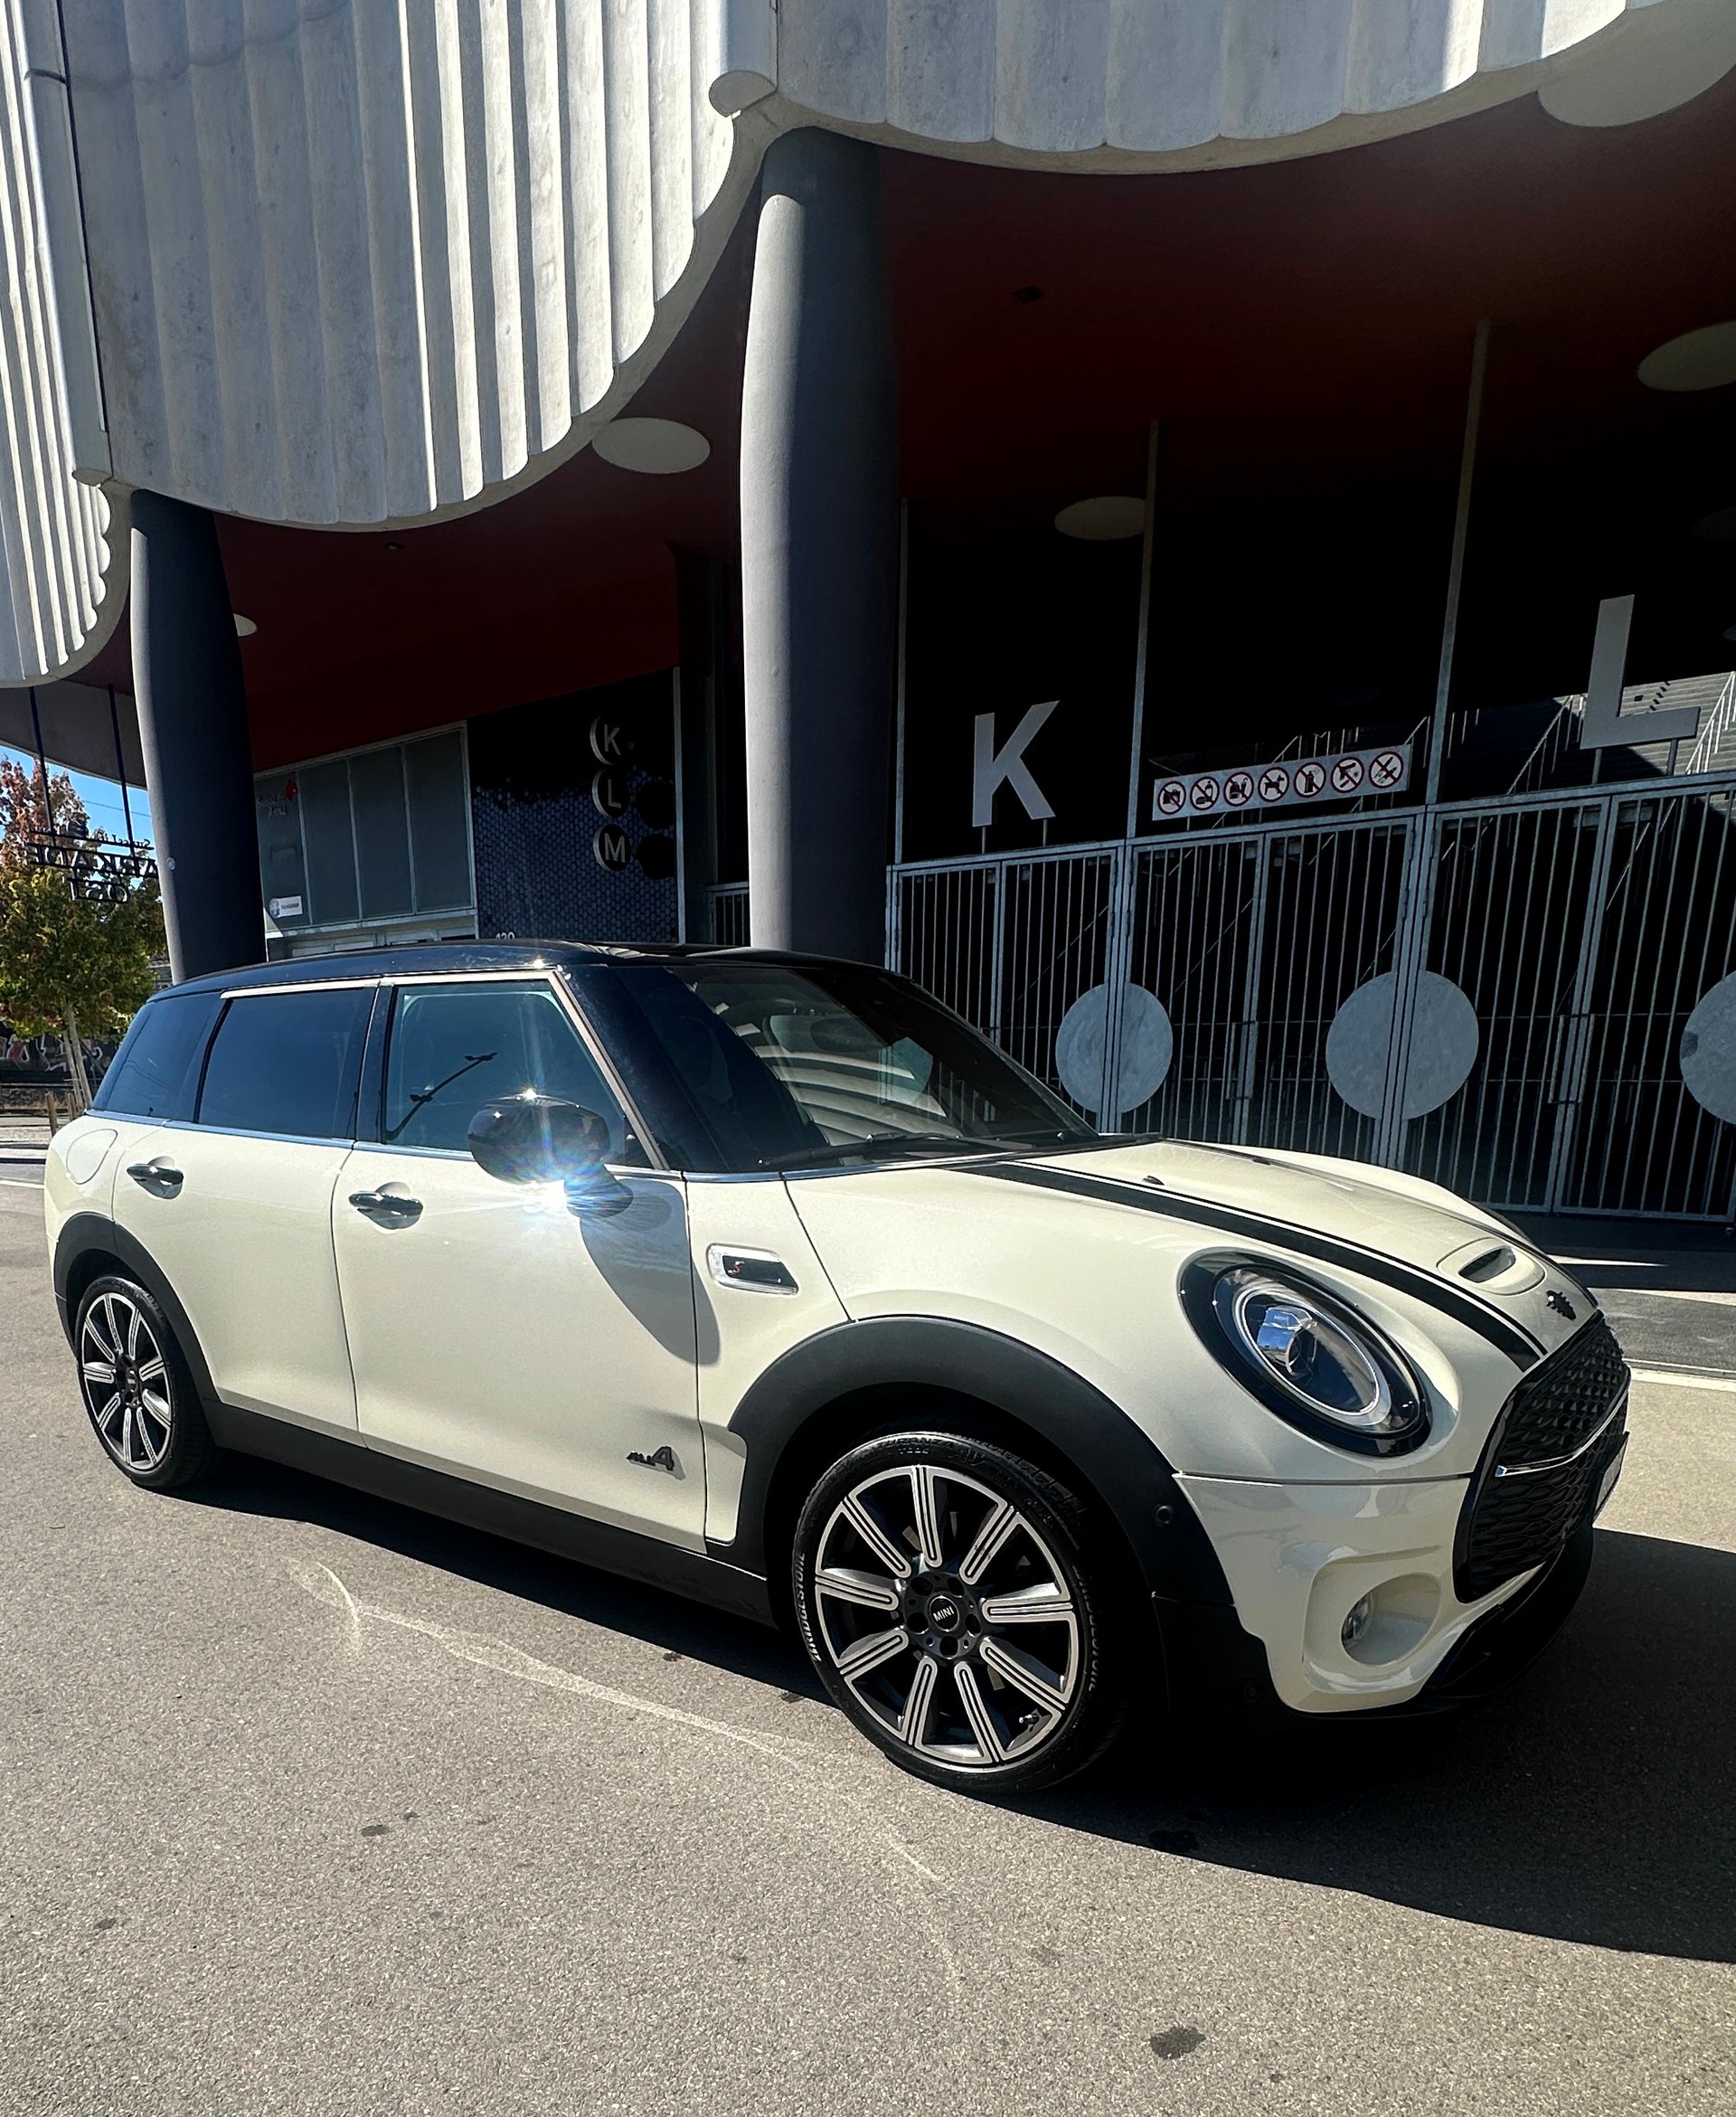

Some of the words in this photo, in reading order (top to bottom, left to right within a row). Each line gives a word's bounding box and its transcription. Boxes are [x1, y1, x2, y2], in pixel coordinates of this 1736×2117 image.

[1580, 594, 1700, 750] L
[604, 724, 621, 755] K
[973, 700, 1061, 827] K
[608, 779, 622, 808] L
[605, 833, 626, 863] M
[933, 1605, 955, 1621] MINI
